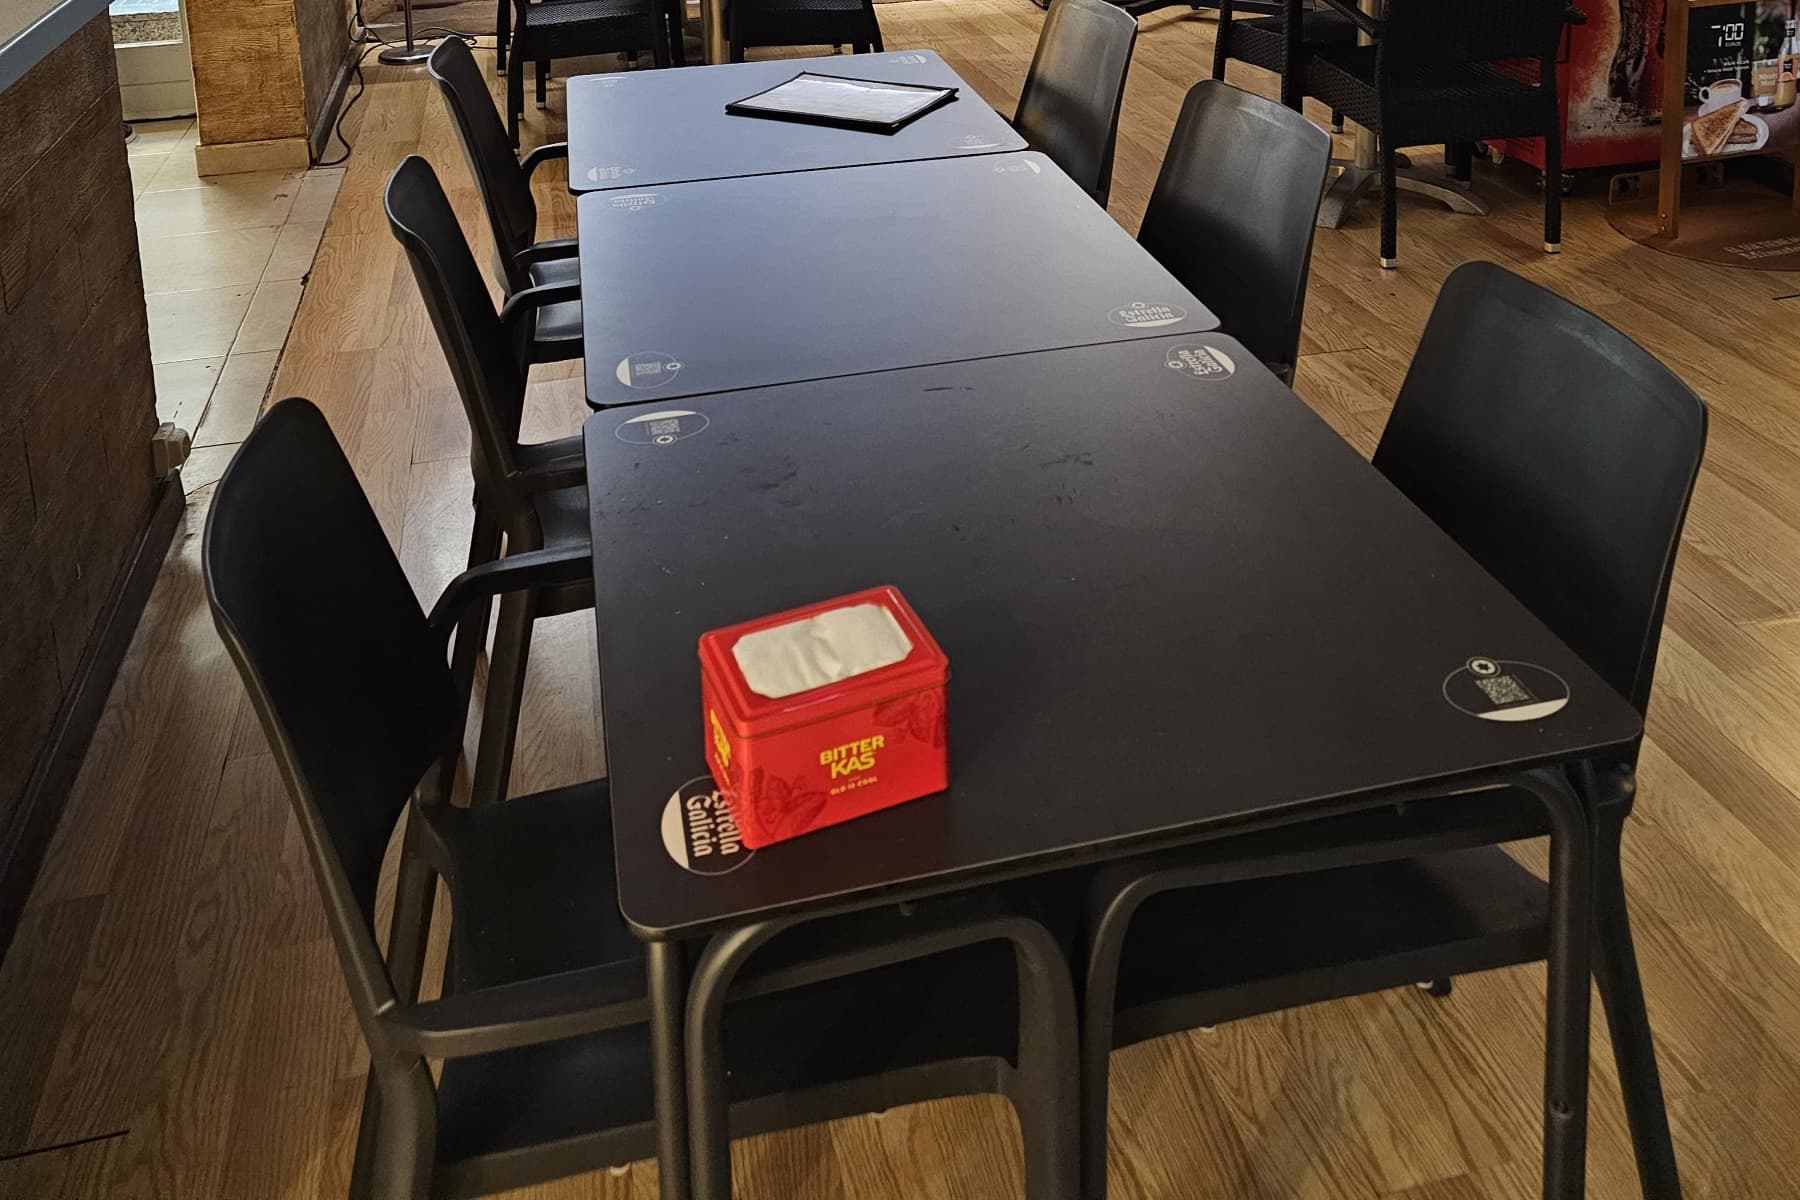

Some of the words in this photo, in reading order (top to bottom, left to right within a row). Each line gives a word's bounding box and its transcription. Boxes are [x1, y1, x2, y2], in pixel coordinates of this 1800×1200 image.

[819, 734, 885, 766] BITTER
[831, 751, 876, 779] KAS
[686, 794, 718, 858] Galicia
